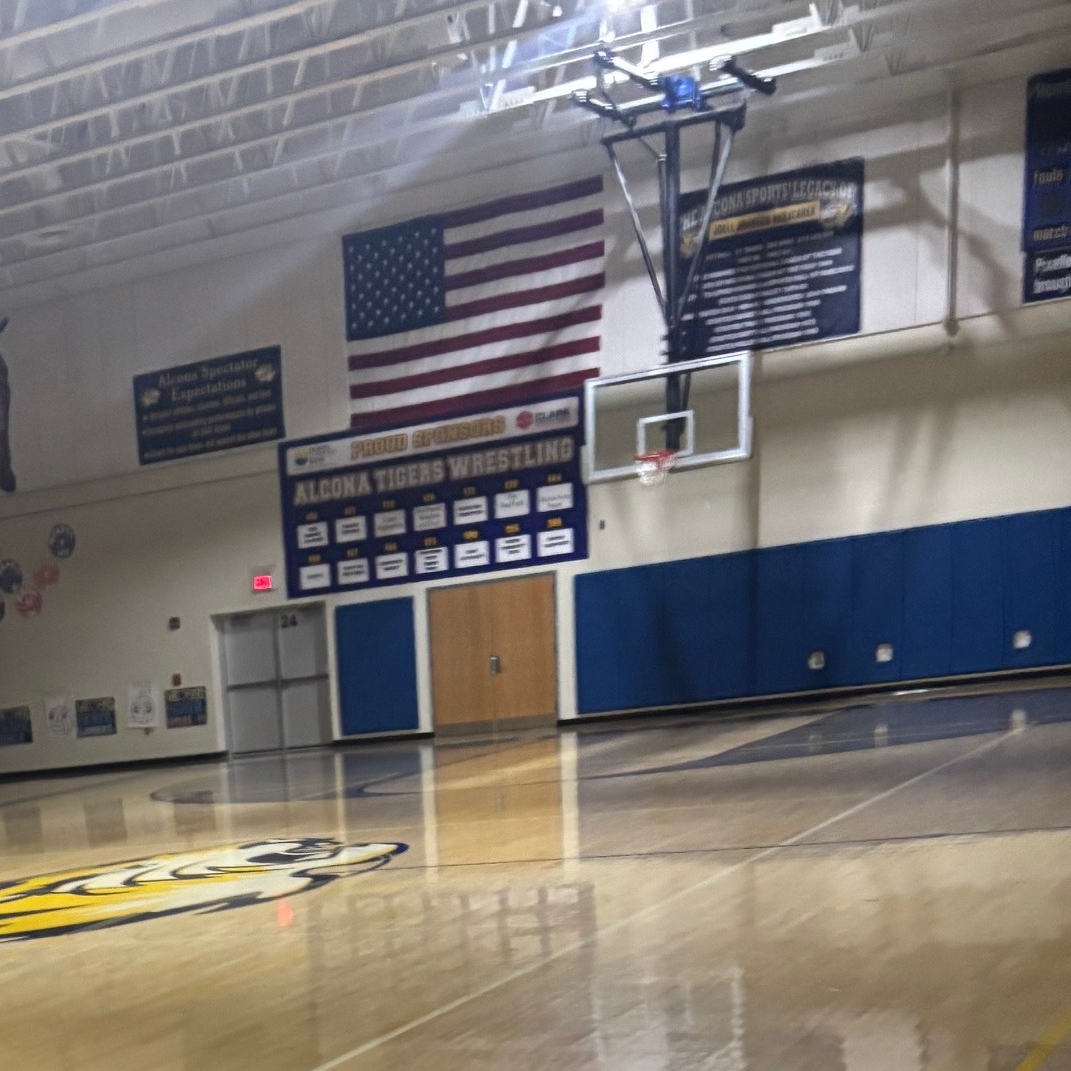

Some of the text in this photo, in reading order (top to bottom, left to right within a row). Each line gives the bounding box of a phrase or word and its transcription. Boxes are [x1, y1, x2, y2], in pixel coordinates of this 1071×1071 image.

[745, 183, 789, 206] SPORTS
[158, 358, 258, 389] Alcona Spectator
[171, 377, 247, 402] Expectations
[350, 433, 409, 461] PROUD
[411, 415, 507, 449] SPONSORS
[293, 435, 574, 506] ALCONA TIGERS WRESTLING
